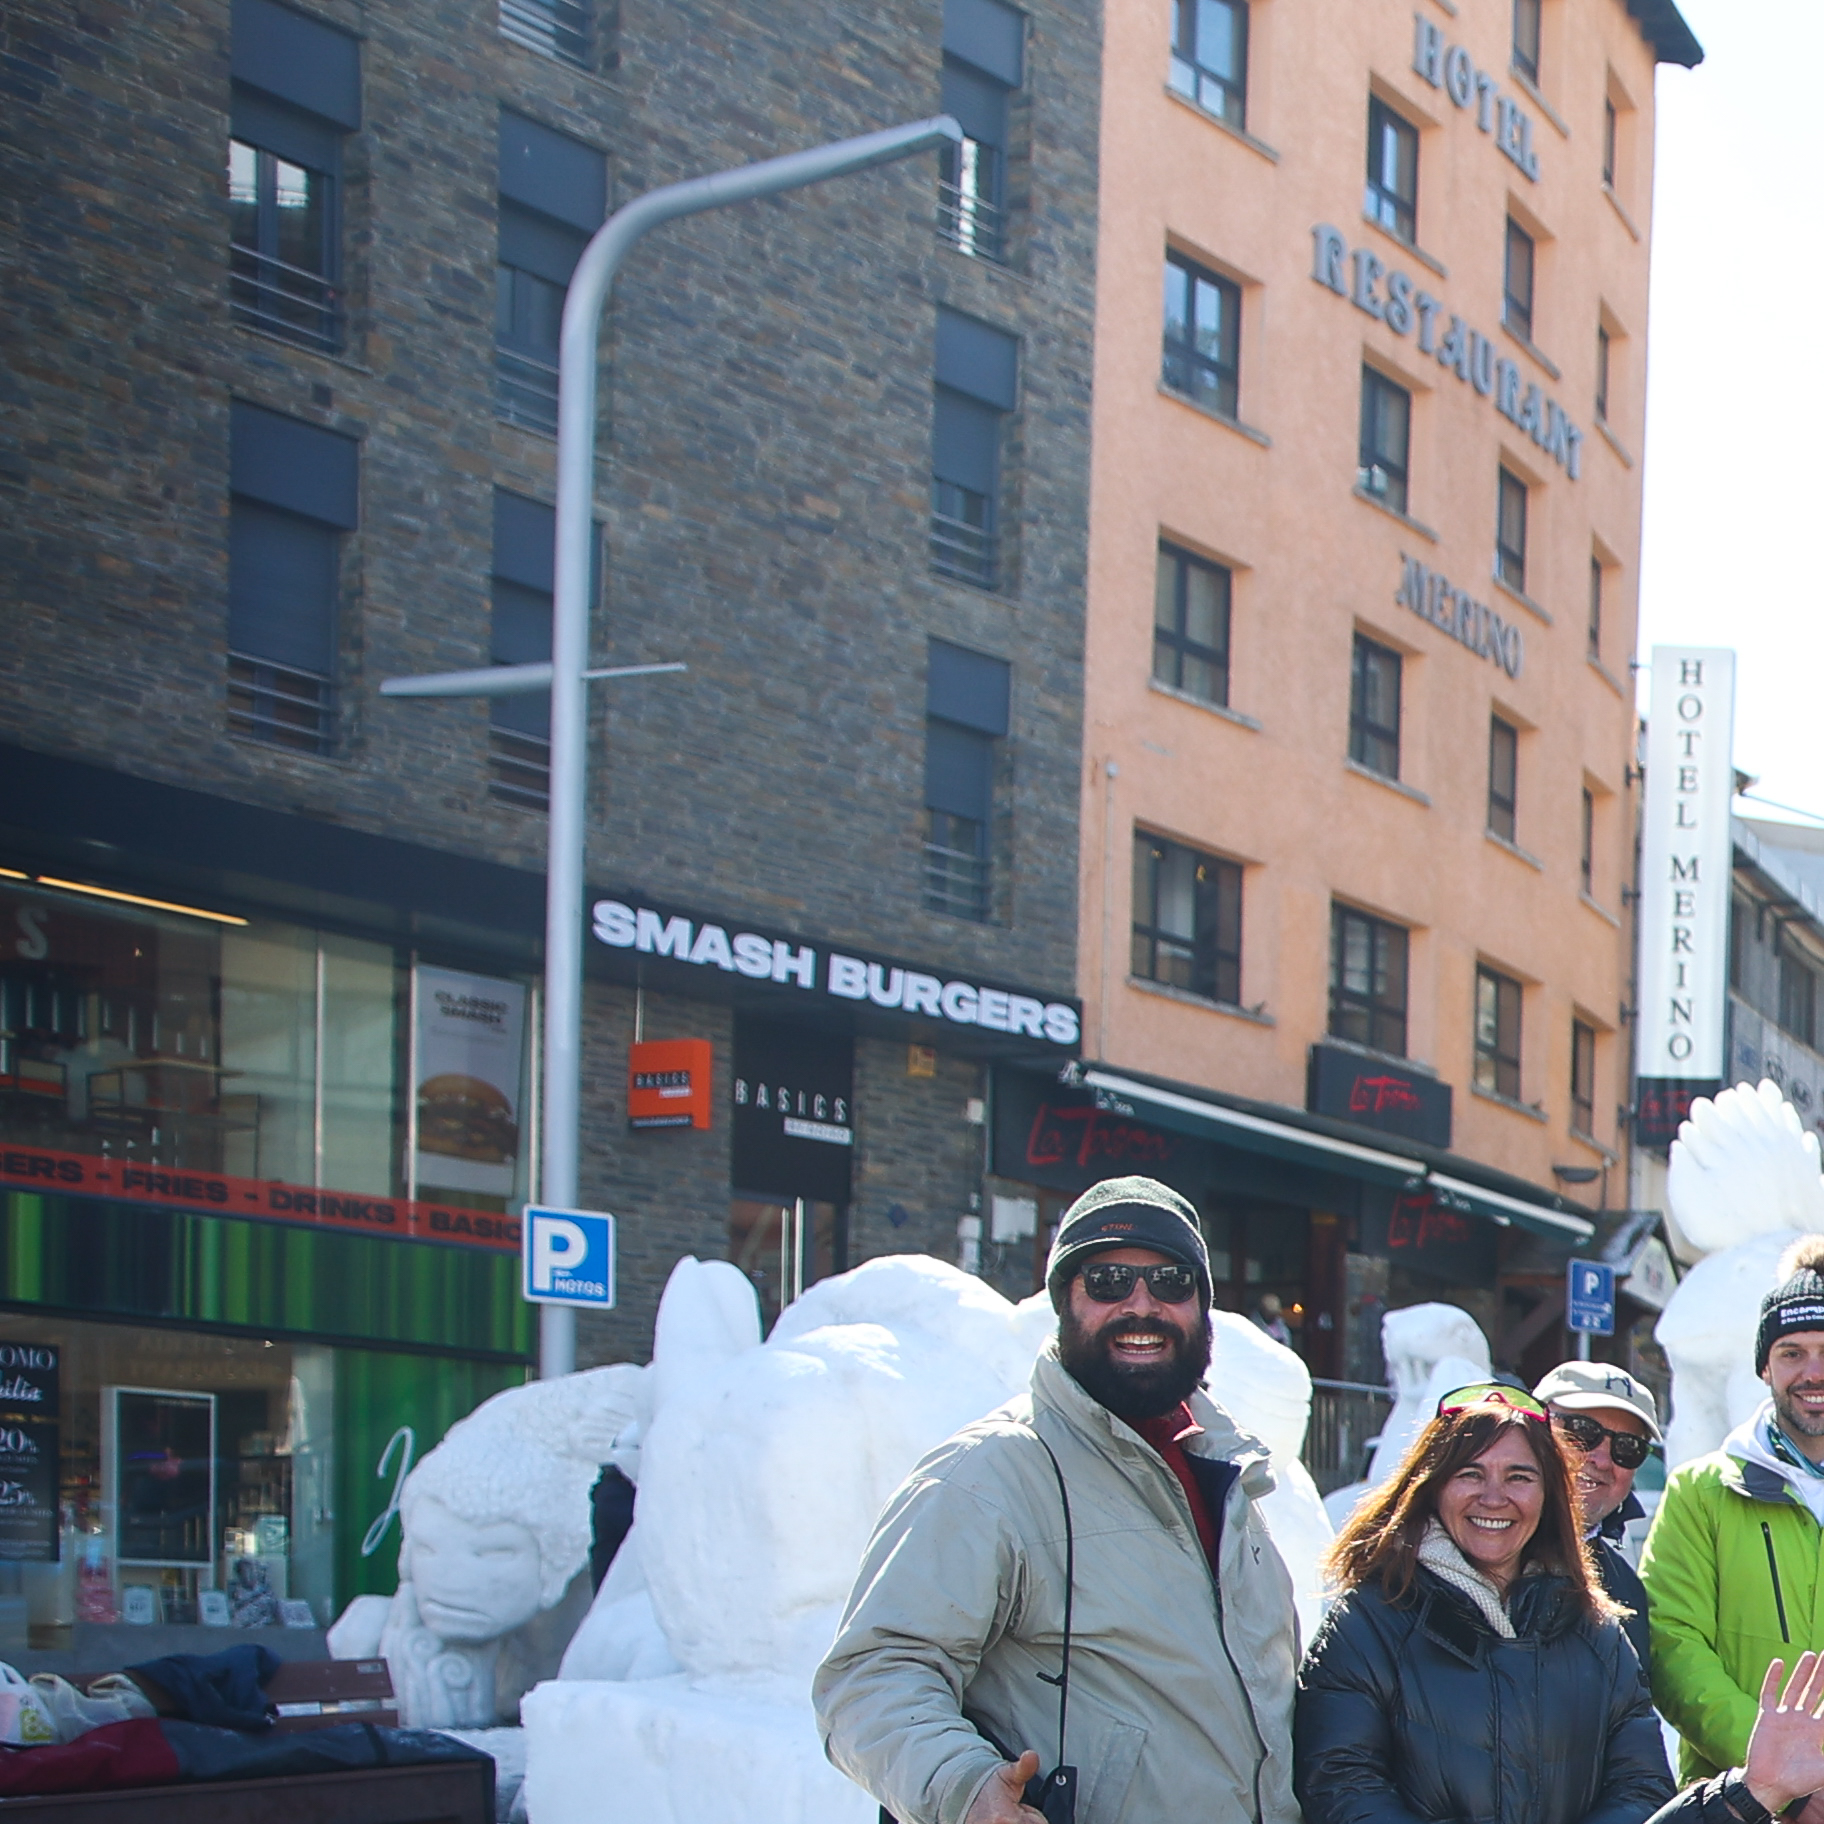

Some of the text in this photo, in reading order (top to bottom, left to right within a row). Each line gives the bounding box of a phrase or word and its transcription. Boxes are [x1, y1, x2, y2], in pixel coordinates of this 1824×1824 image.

[1413, 11, 1540, 184] HOTEL
[1310, 222, 1584, 482] RESTAURANT
[1395, 552, 1524, 679] MERINO
[1675, 658, 1704, 829] HOTEL
[592, 898, 1081, 1045] SMASH BURGERS
[1667, 854, 1703, 1062] MERINO
[636, 1071, 691, 1089] BASICS
[734, 1077, 848, 1123] BASICS
[121, 1167, 230, 1206] FRIES
[267, 1186, 397, 1227] DRINKS
[533, 1216, 590, 1292] P
[1584, 1270, 1600, 1295] P
